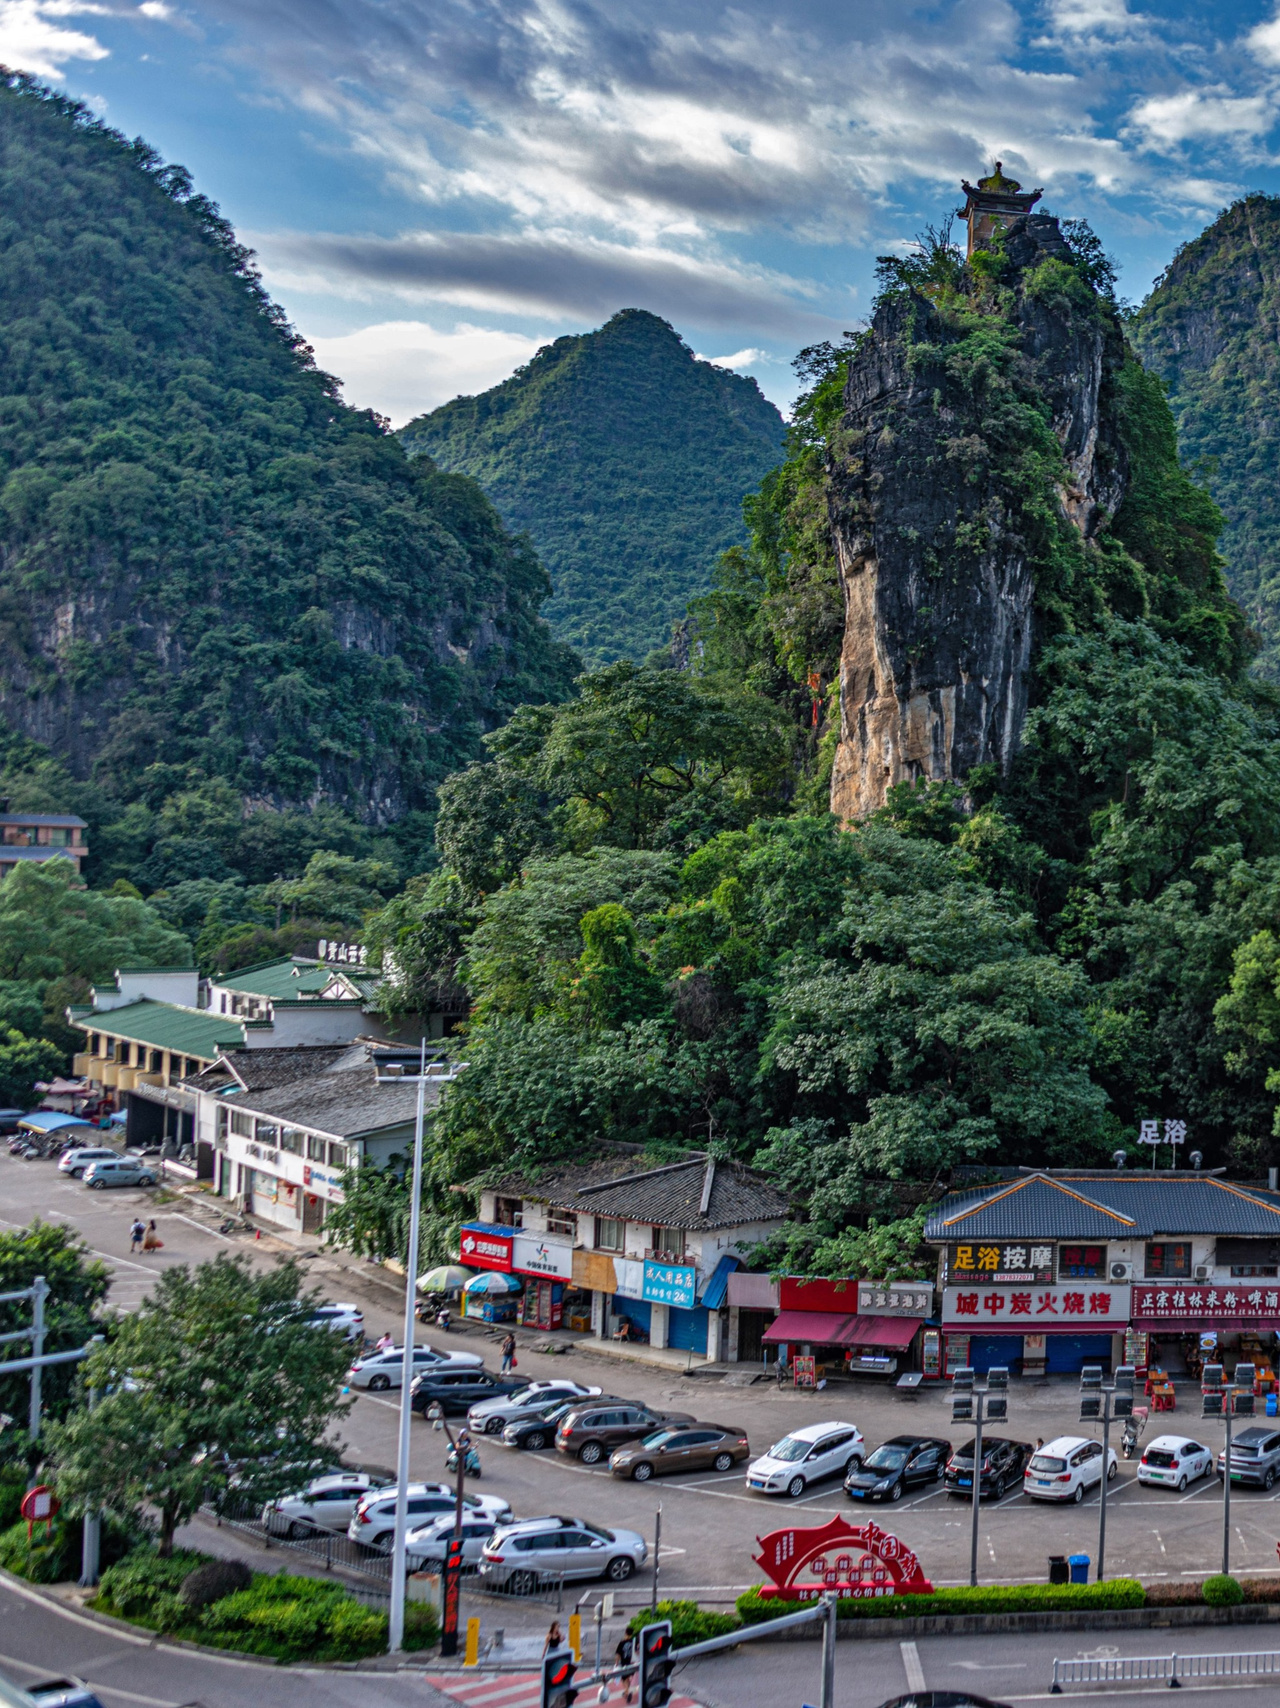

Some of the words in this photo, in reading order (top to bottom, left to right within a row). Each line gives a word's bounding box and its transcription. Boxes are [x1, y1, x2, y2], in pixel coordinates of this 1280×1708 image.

[1137, 1119, 1187, 1144] 足浴
[953, 1246, 1053, 1270] 足浴按摩
[646, 1267, 693, 1288] 成人用品店
[954, 1272, 989, 1281] Massage
[955, 1292, 1112, 1316] 城中炭火烧烤
[859, 1518, 920, 1583] 中国梦
